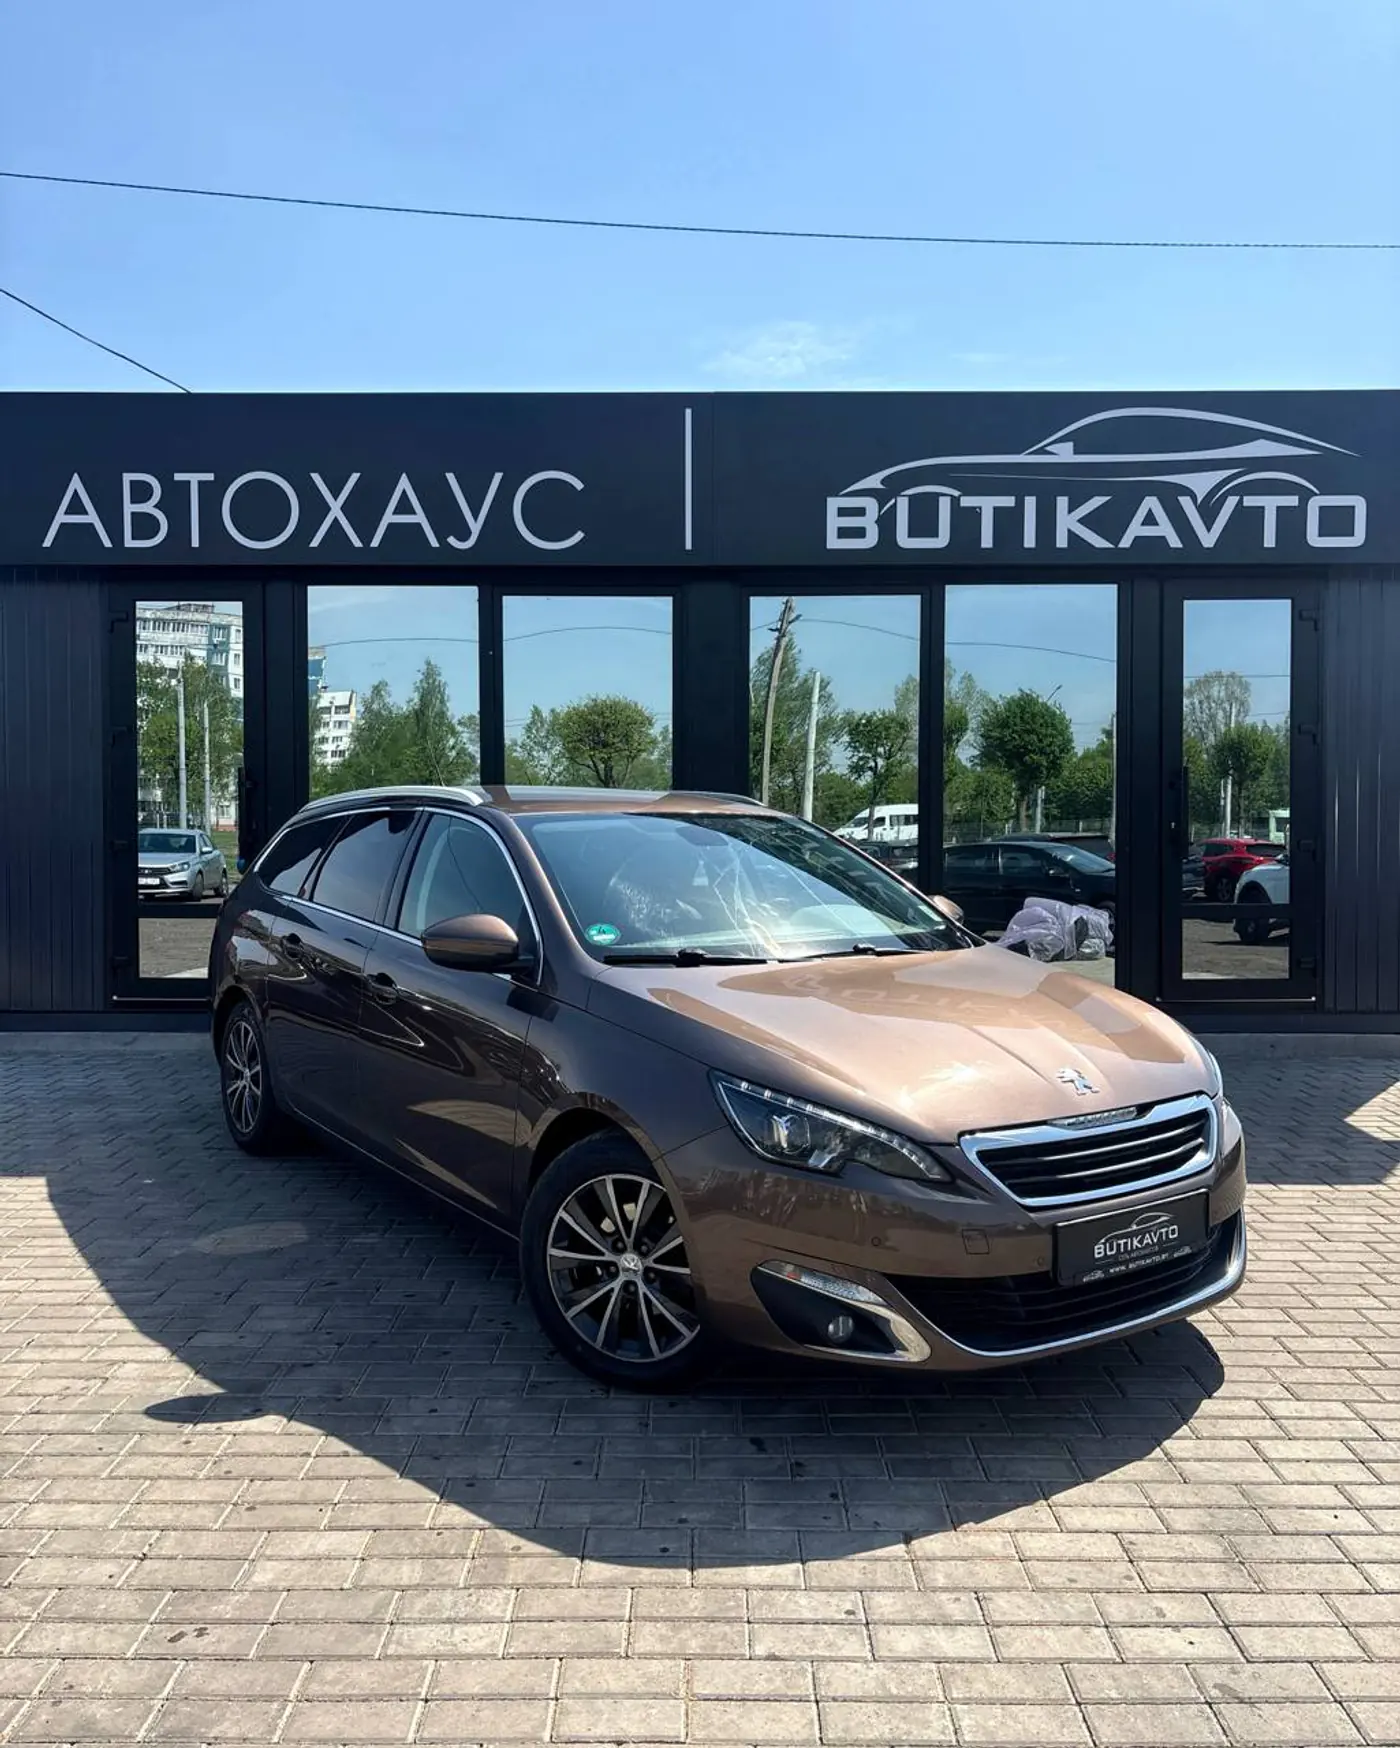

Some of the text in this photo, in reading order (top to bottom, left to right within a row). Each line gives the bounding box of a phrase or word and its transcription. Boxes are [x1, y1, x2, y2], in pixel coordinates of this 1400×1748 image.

[42, 470, 586, 550] АВТОХАУС
[826, 495, 1368, 549] BUTIKAVTO
[1094, 1224, 1179, 1259] BUTIKAVTO
